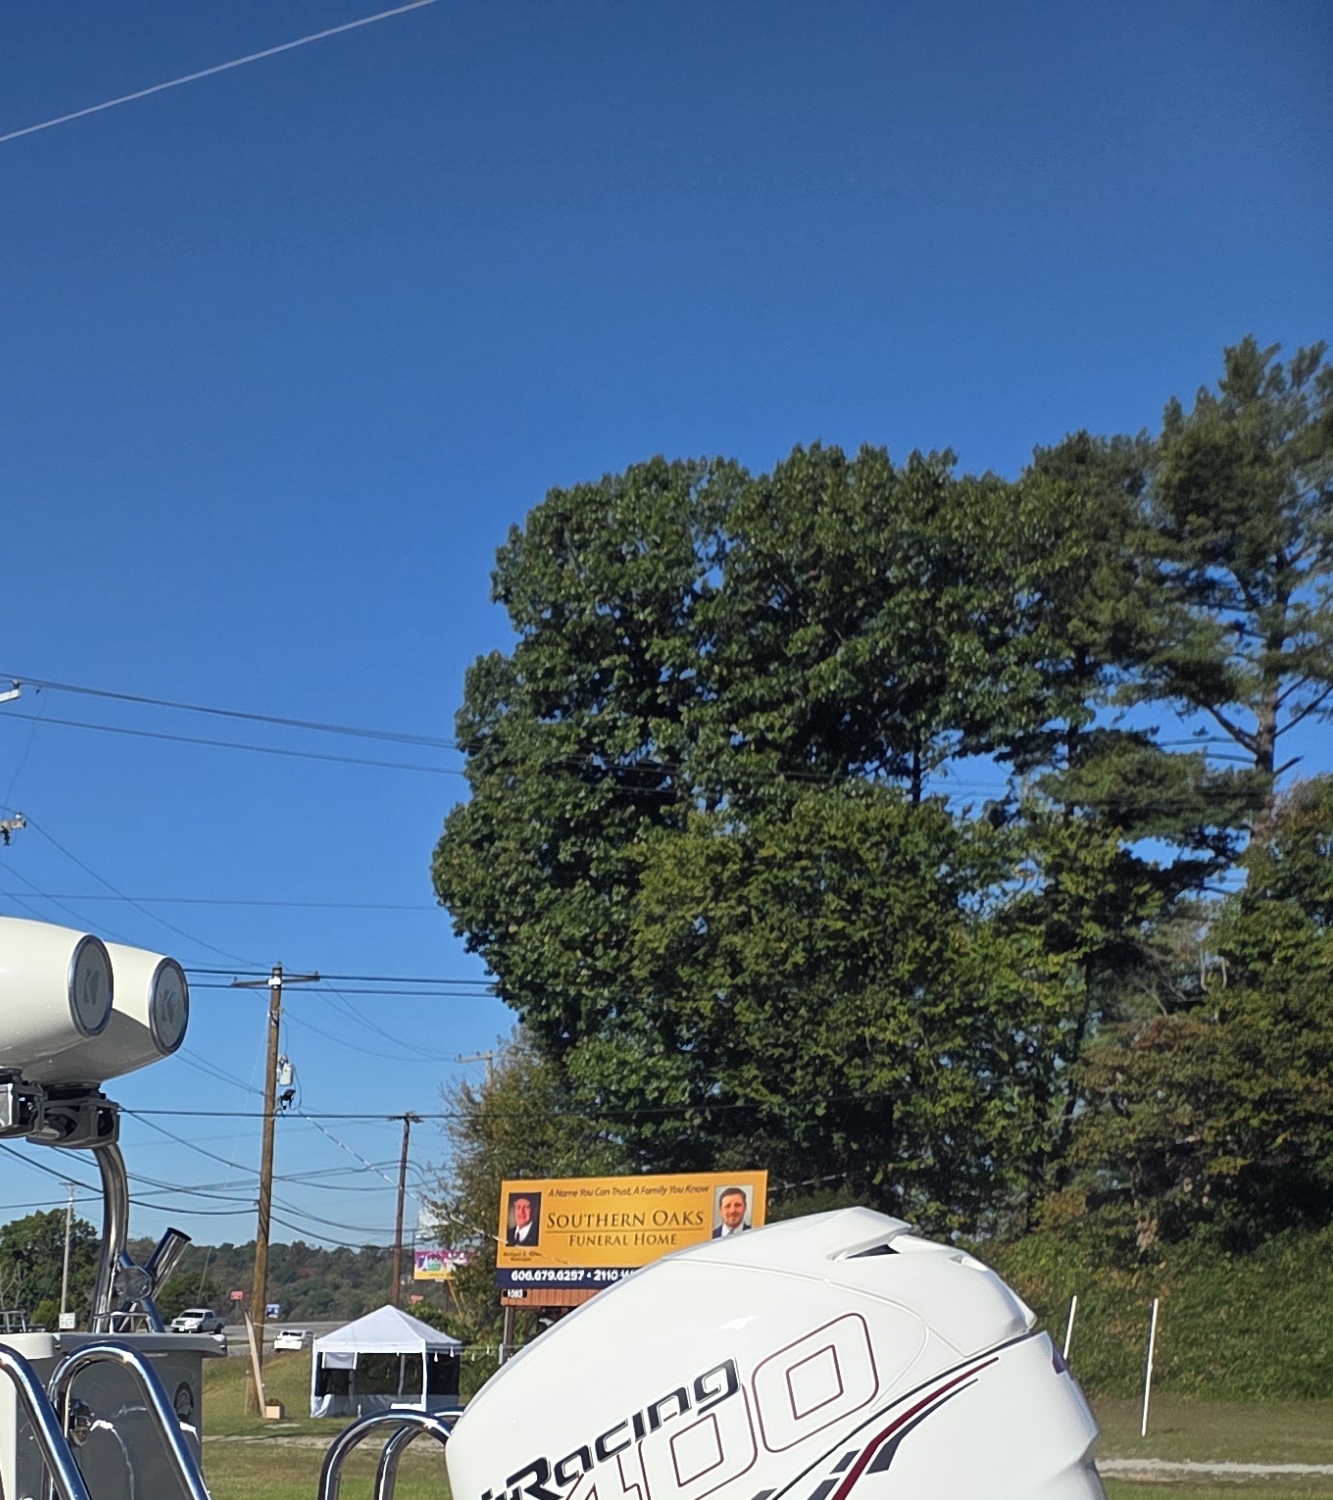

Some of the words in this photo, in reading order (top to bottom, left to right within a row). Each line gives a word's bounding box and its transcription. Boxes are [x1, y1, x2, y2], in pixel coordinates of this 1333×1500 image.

[555, 1188, 578, 1197] Name
[580, 1188, 593, 1198] You
[595, 1187, 610, 1196] Can
[641, 1185, 667, 1197] Family
[669, 1185, 684, 1194] You
[685, 1184, 710, 1193] Know
[546, 1211, 646, 1229] SOUTHERN
[652, 1209, 704, 1227] OAKS
[569, 1234, 629, 1247] FUNERAL
[634, 1232, 678, 1246] HOME
